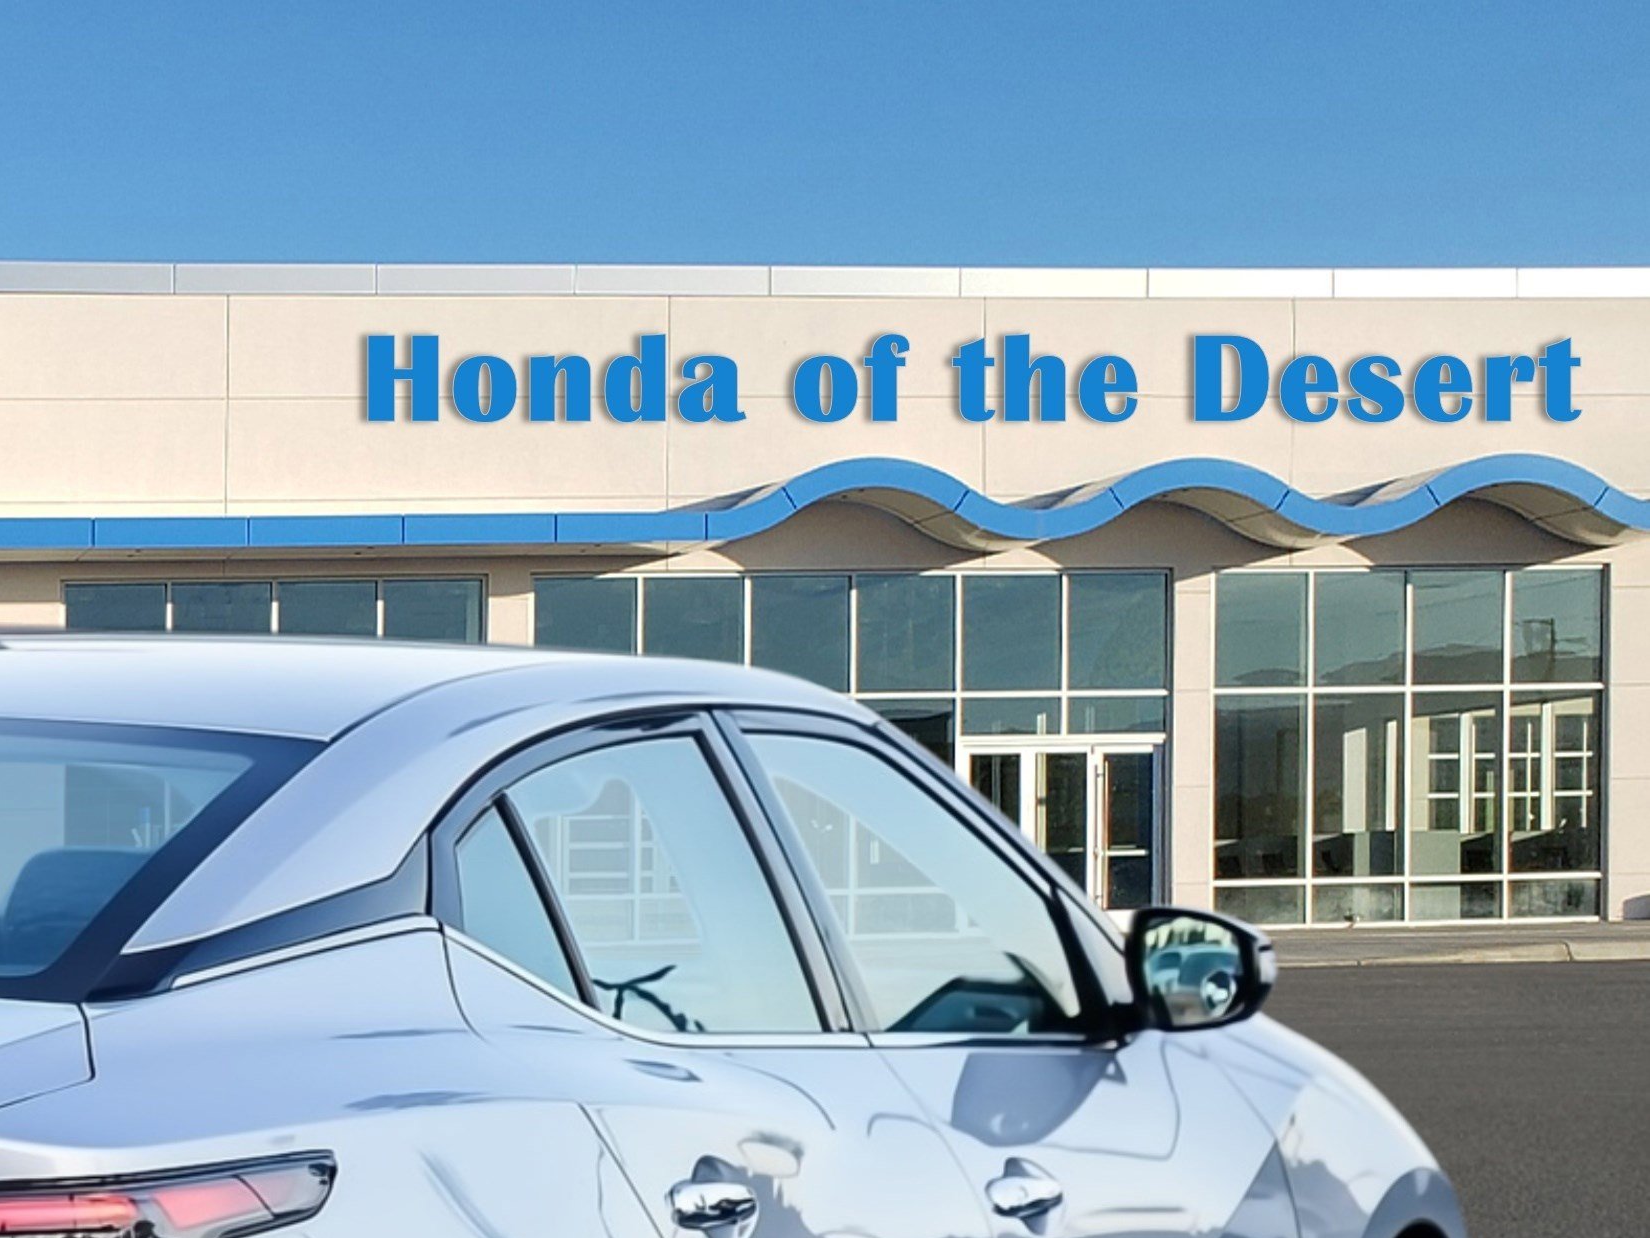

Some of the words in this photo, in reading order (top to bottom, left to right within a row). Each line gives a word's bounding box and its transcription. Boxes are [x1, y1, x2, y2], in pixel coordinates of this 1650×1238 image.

[364, 333, 749, 424] Honda
[791, 333, 912, 424] of
[950, 333, 1141, 424] the
[1186, 334, 1584, 424] Desert
